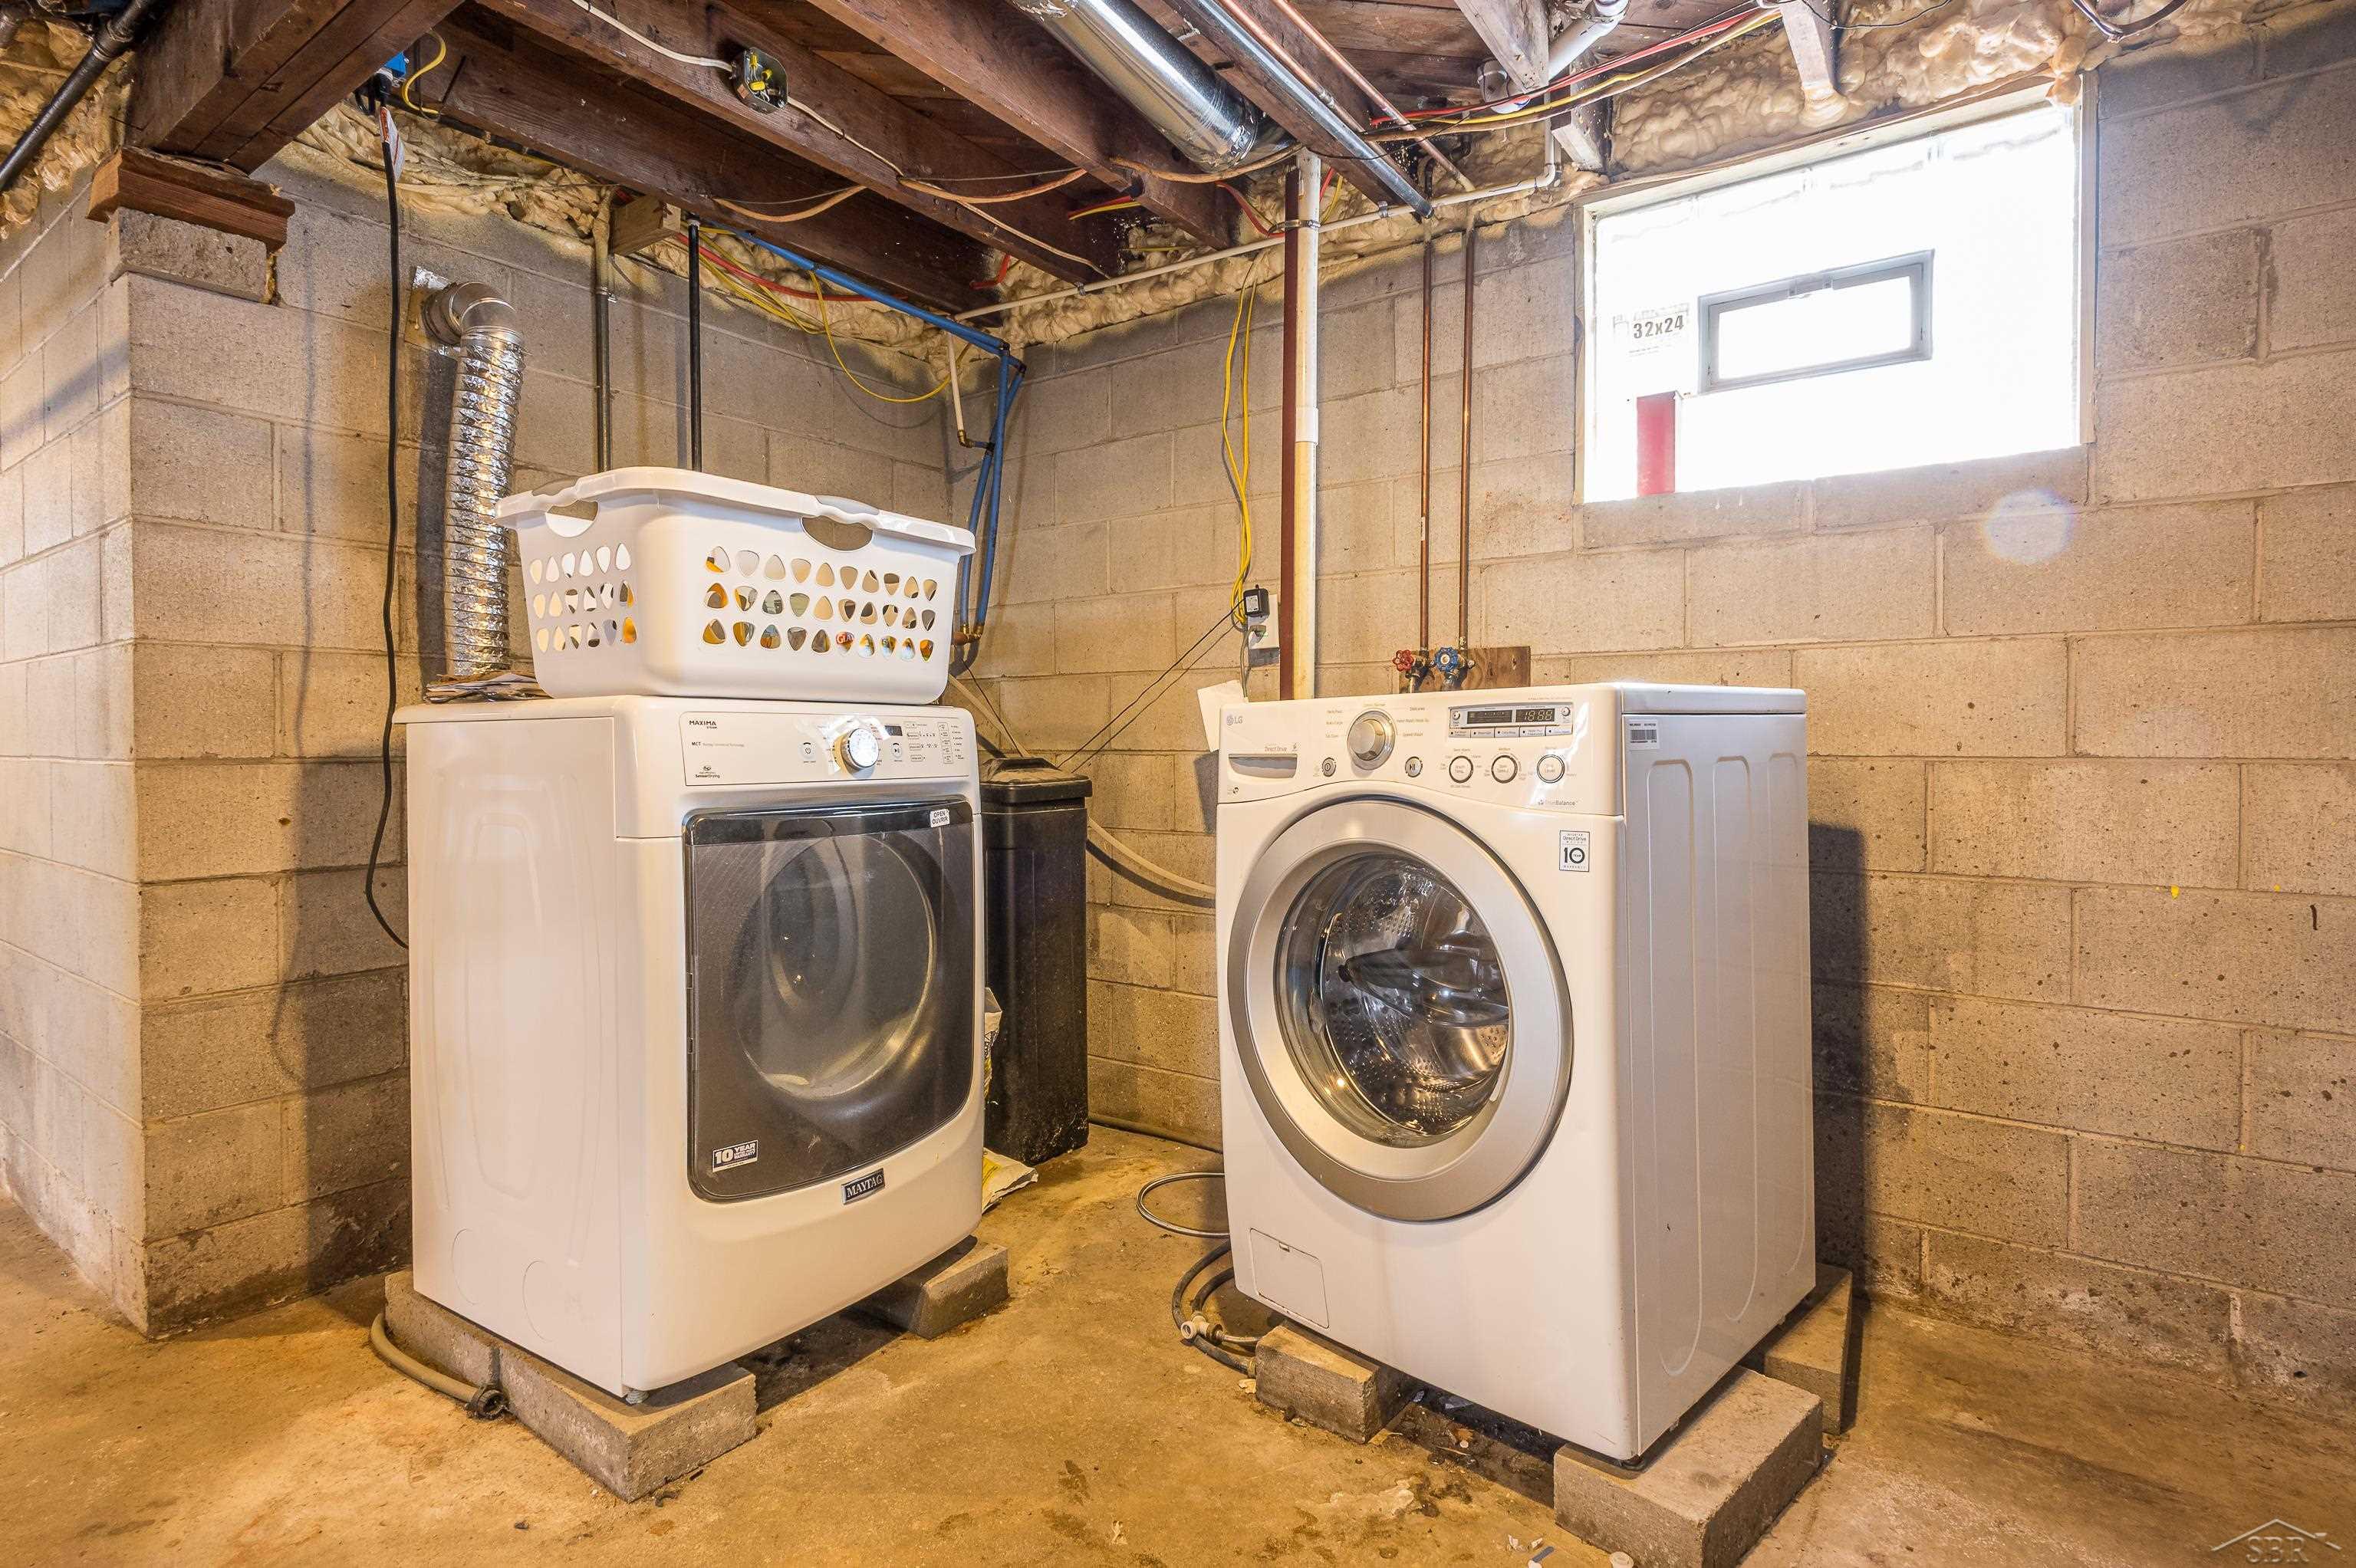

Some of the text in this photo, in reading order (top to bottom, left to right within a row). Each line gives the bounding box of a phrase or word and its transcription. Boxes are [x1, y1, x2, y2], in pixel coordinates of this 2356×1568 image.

[1634, 314, 1684, 339] 32x24
[933, 810, 946, 818] OPEN
[1564, 847, 1585, 864] 10
[715, 1149, 734, 1164] 10
[734, 1142, 756, 1152] YEAR
[846, 1174, 884, 1198] MAYTAG
